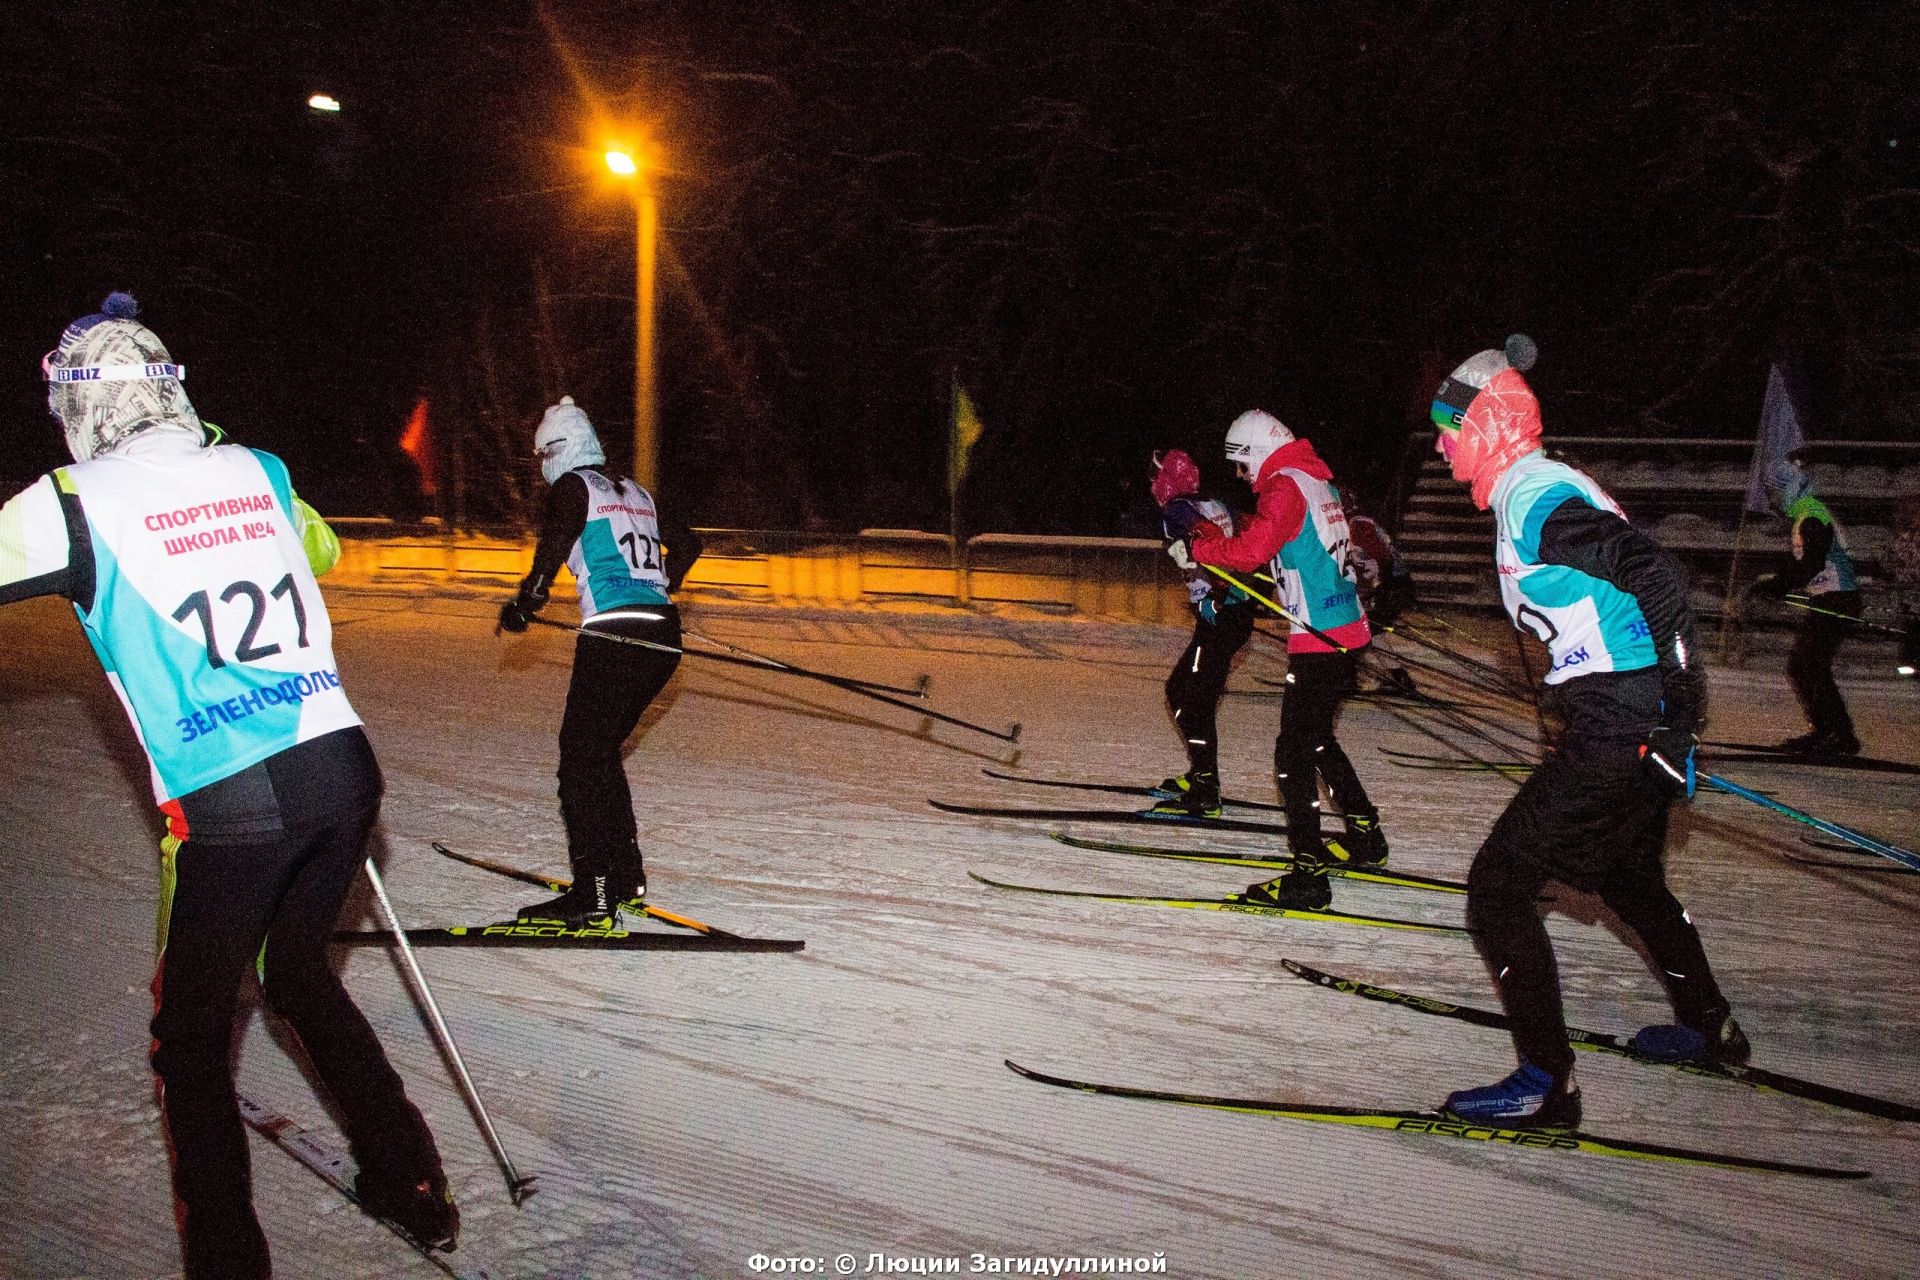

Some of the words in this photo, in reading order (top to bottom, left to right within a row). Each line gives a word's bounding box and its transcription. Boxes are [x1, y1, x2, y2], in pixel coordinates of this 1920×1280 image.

[71, 368, 101, 380] BLIZ
[144, 494, 274, 532] СПОРТИВНАЯ
[164, 526, 241, 556] ШКОЛА
[242, 521, 276, 540] №4
[171, 573, 310, 670] 121
[594, 876, 608, 910] INOVIK
[1219, 904, 1286, 919] FISCHER
[482, 926, 630, 939] FISCHER
[1395, 1119, 1581, 1150] FISCHER
